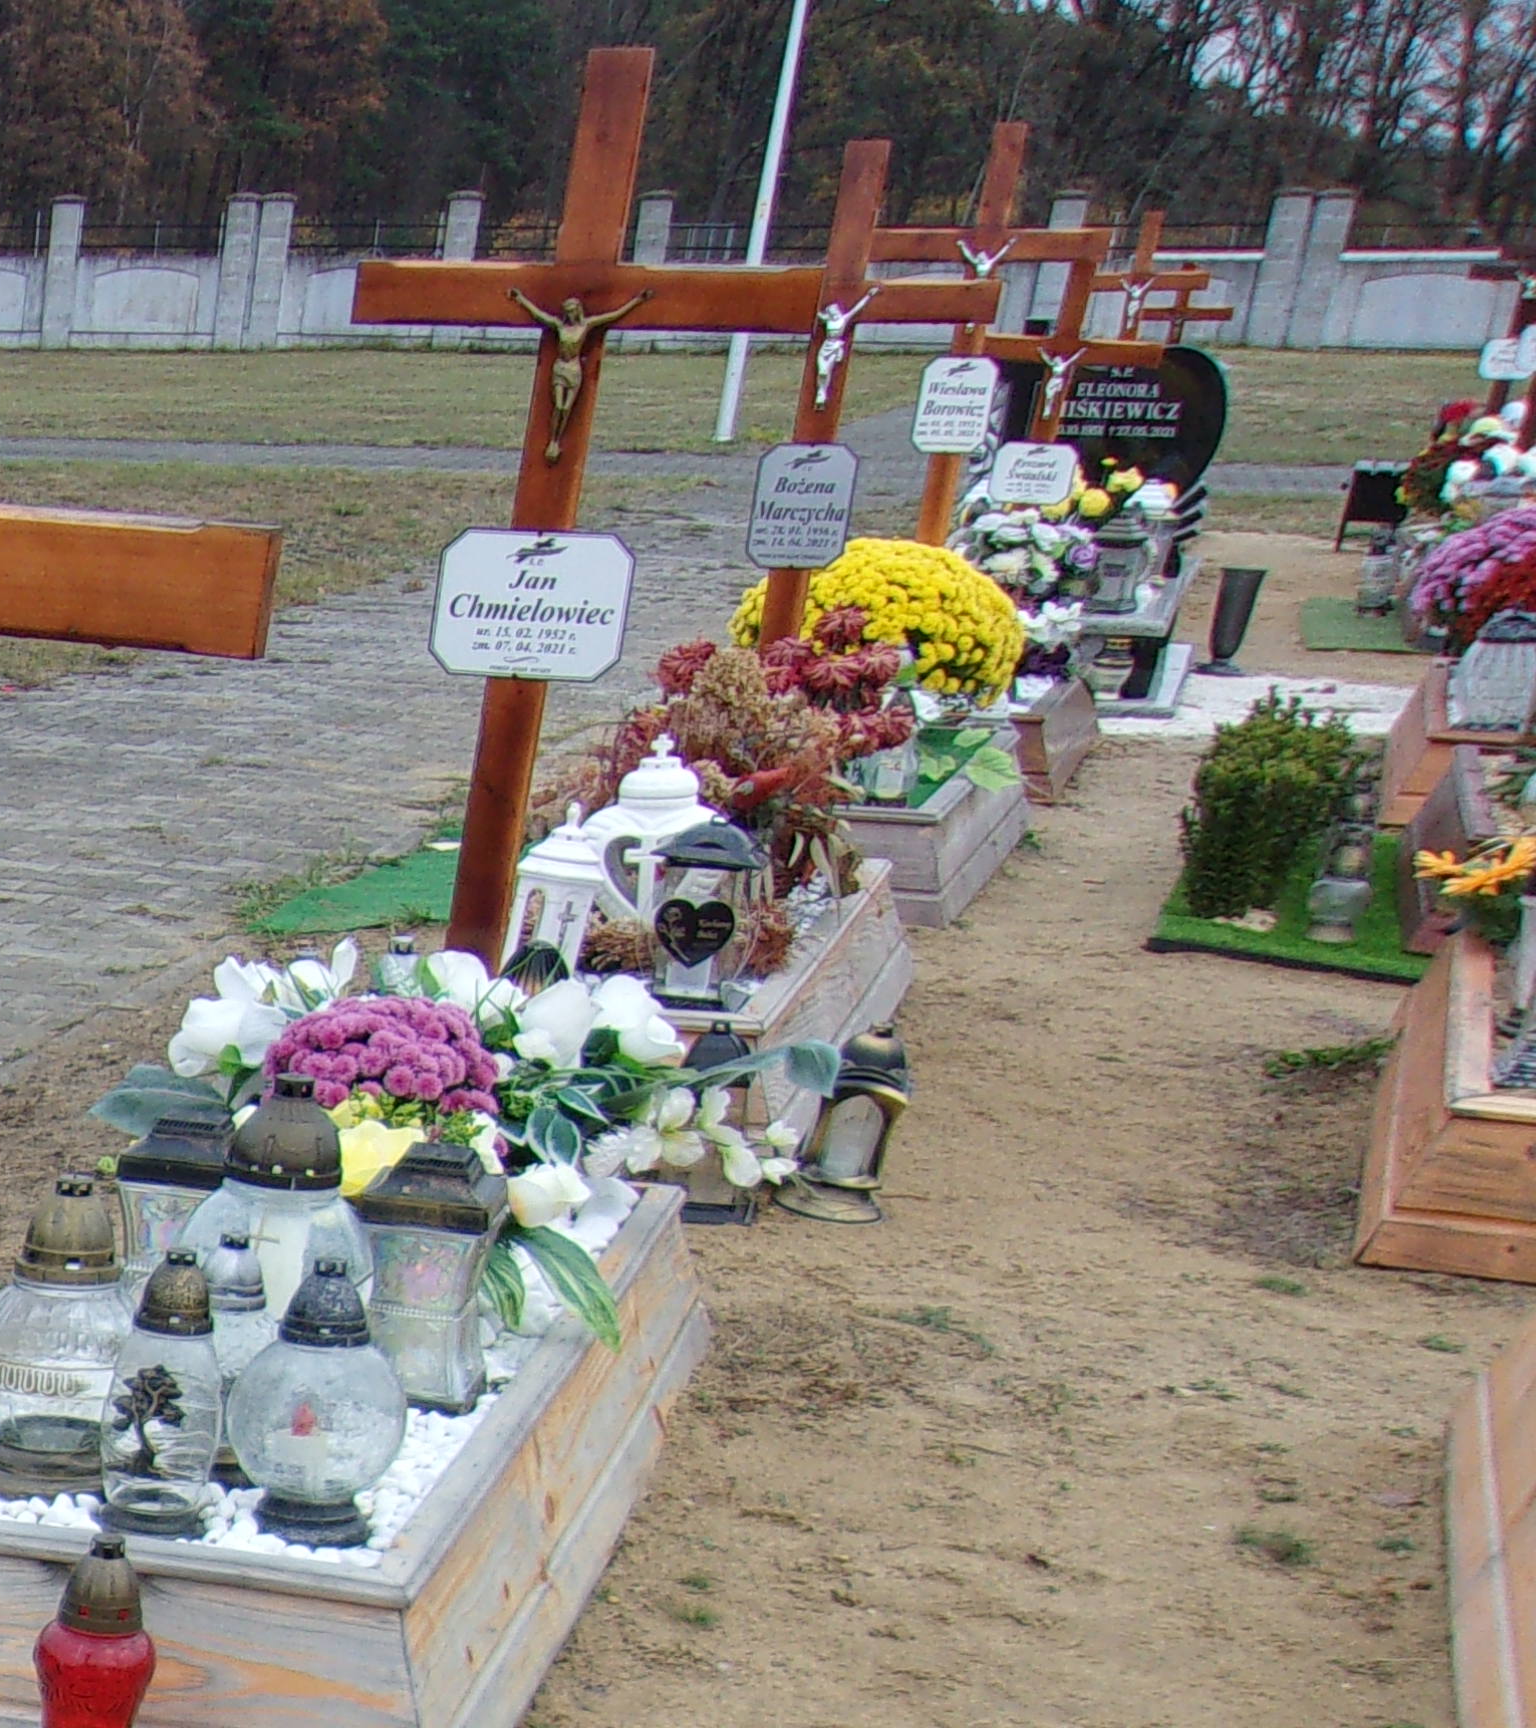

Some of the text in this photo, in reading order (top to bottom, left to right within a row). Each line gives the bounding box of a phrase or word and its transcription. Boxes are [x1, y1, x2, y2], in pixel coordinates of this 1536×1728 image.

[1076, 382, 1160, 398] ELEONORA
[774, 477, 837, 495] Bożena
[755, 501, 847, 525] Marczycha
[508, 570, 558, 591] Jan
[449, 593, 616, 626] Chmielowiec
[537, 628, 567, 640] 1952
[536, 643, 565, 655] 2021
